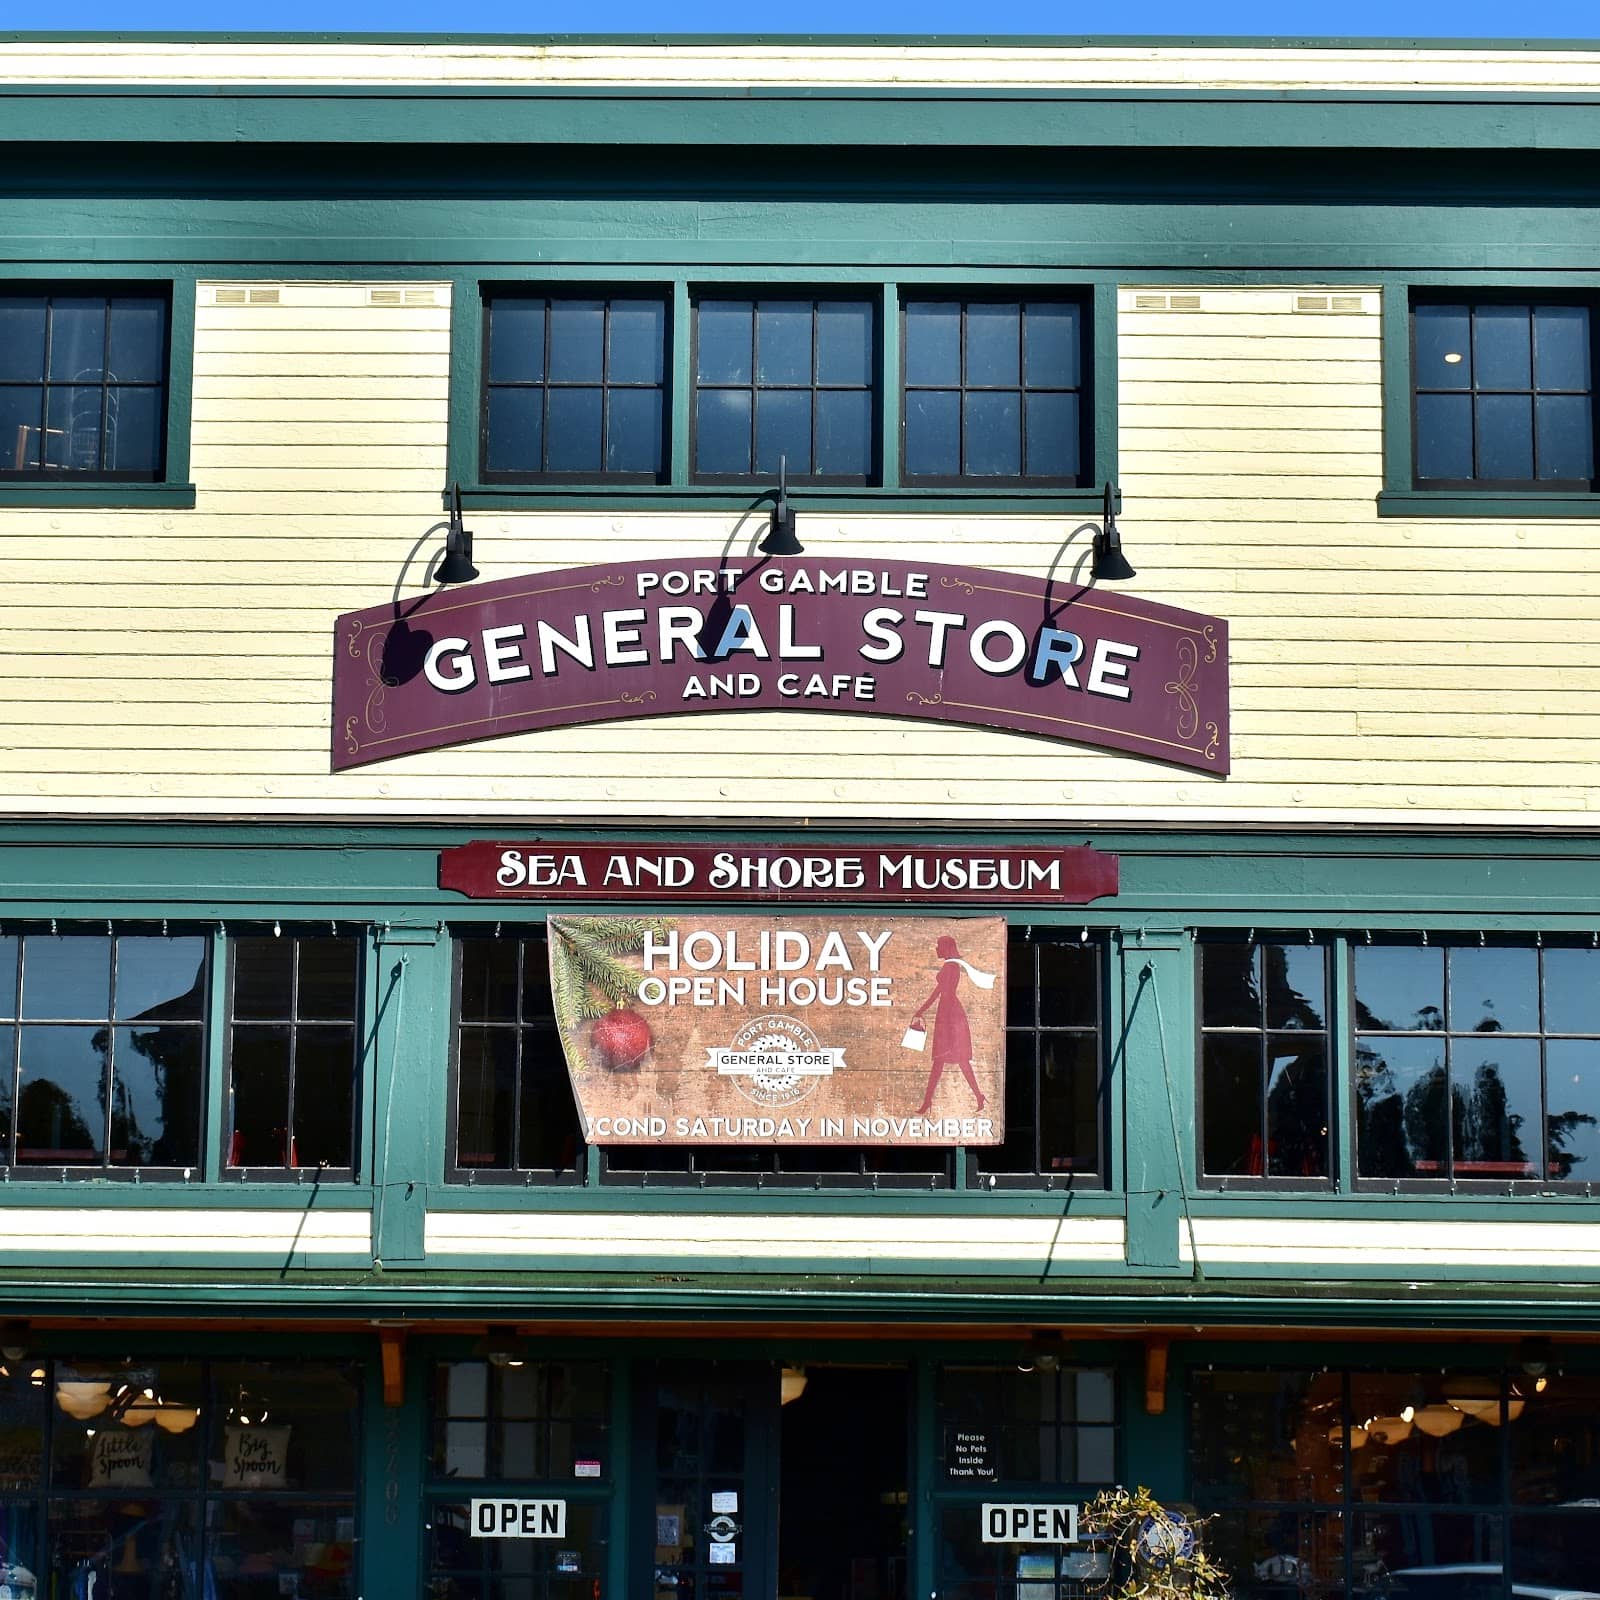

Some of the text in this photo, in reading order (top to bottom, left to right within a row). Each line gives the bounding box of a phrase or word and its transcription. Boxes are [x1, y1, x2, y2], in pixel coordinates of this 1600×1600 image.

[636, 570, 930, 598] PORT GAMBLE
[423, 604, 1140, 700] GENERAL STORE
[681, 674, 762, 700] AND
[602, 855, 695, 888] AND
[643, 931, 893, 971] HOLIDAY
[637, 977, 893, 1007] OPEN HOUSE
[737, 1020, 814, 1047] PORT GAMBLE
[721, 1055, 830, 1065] GENERAL STORE
[751, 1088, 778, 1101] SINCE
[676, 1117, 813, 1137] SATURDAY
[820, 1117, 845, 1137] IN
[853, 1117, 995, 1137] NOVEMBER
[239, 1433, 272, 1461] Big
[955, 1445, 987, 1453] No Pets
[957, 1433, 985, 1442] Please
[949, 1468, 994, 1476] Thank You!
[959, 1457, 984, 1465] Inside
[479, 1503, 558, 1533] OPEN
[990, 1508, 1070, 1539] OPEN
